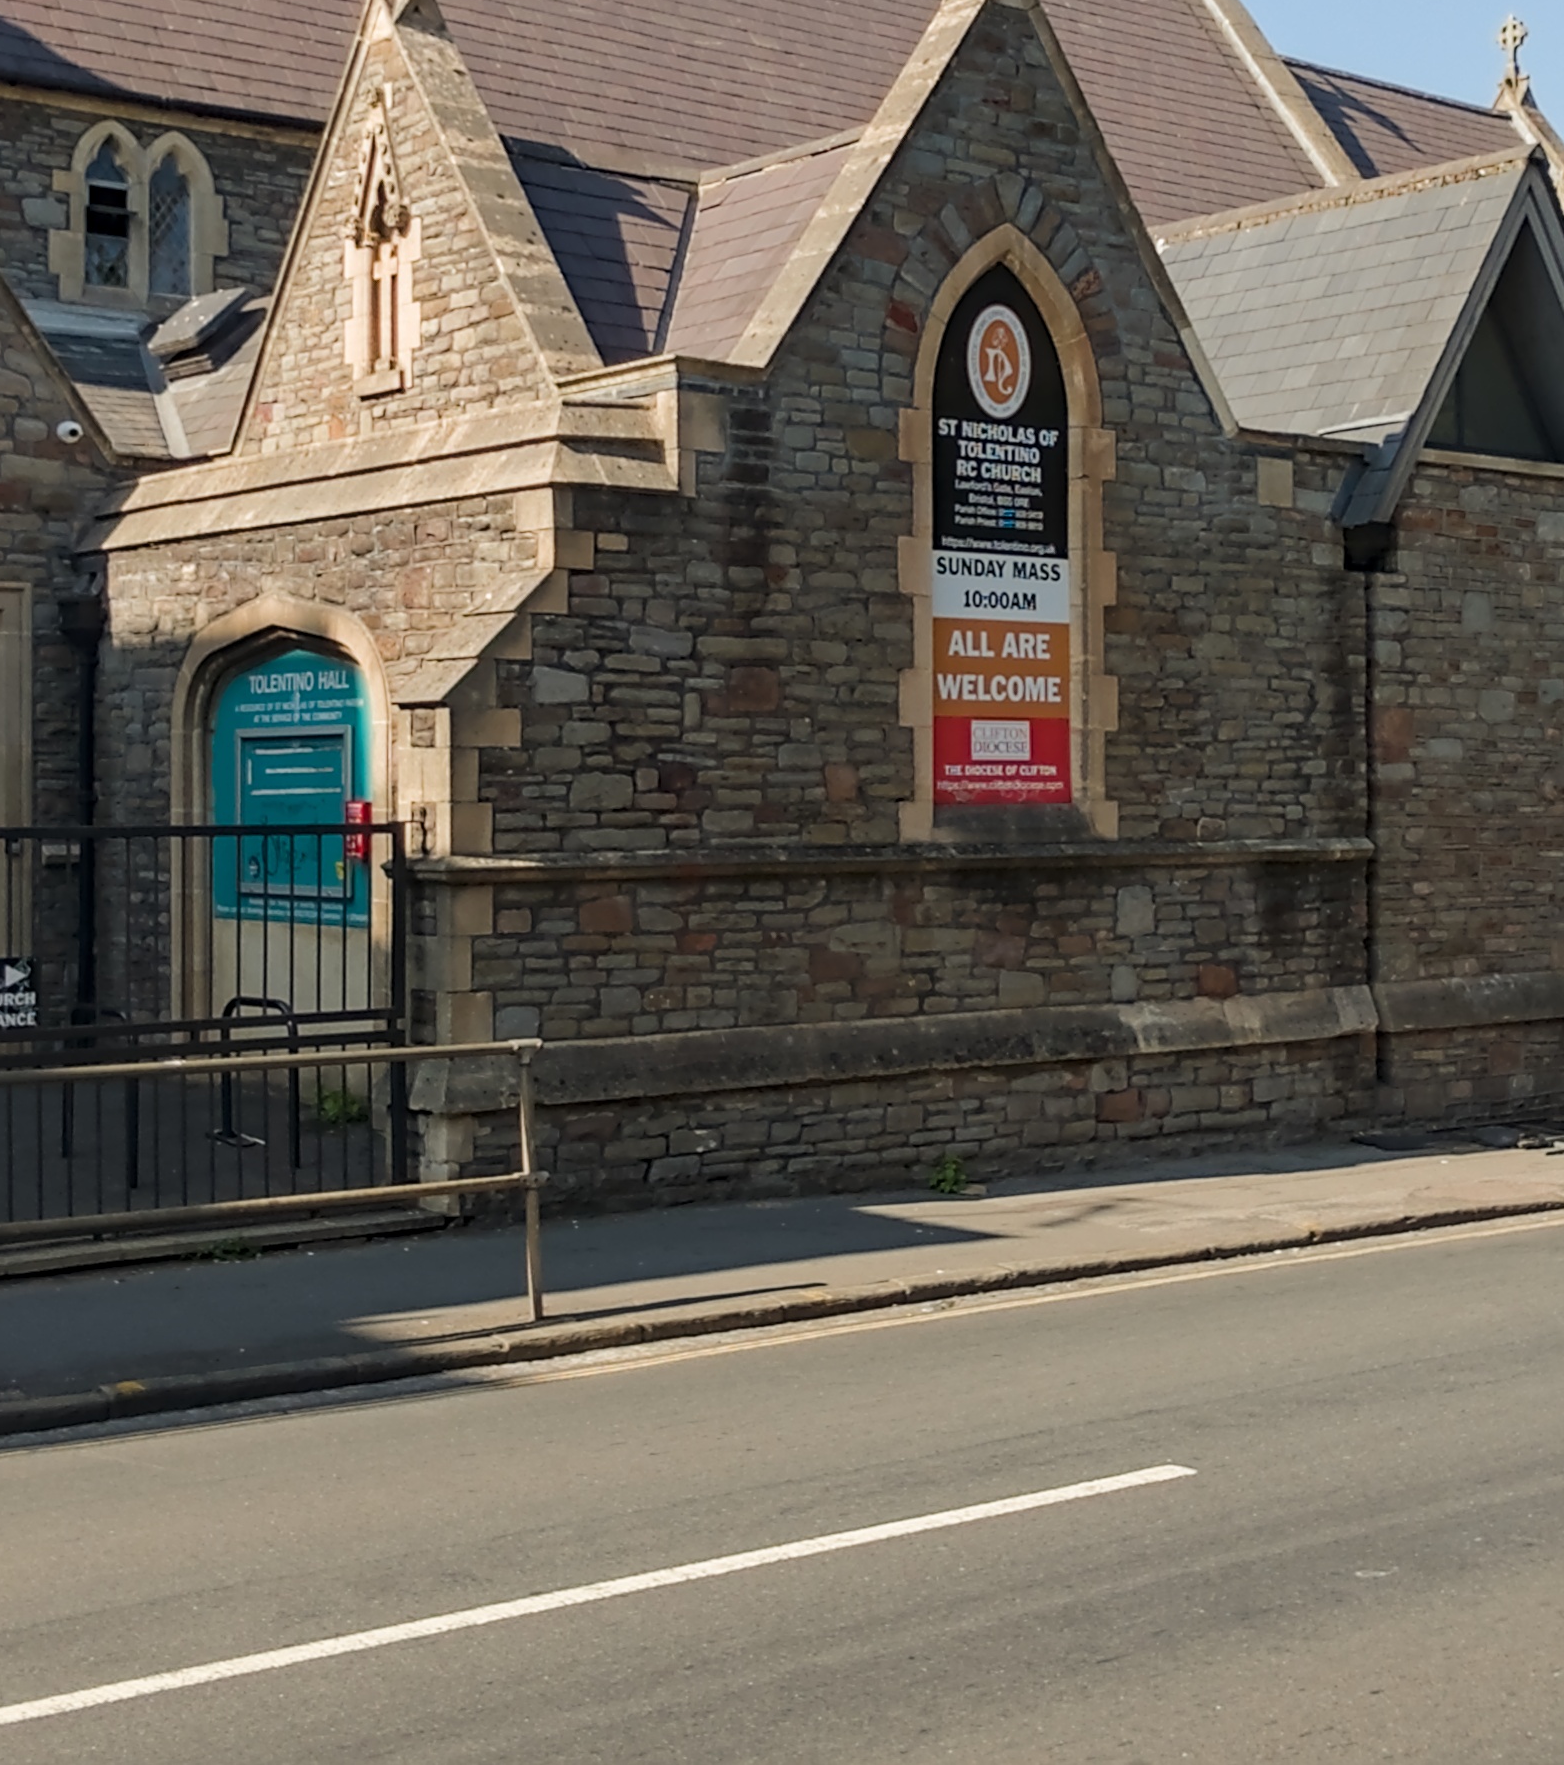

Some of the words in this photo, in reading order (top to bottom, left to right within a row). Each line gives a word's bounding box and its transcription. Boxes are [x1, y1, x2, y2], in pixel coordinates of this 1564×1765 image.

[938, 418, 958, 436] ST
[962, 421, 1035, 445] NICHOLAS
[1039, 430, 1059, 447] OF
[958, 440, 1040, 464] TOLENTINO
[956, 459, 978, 478] RC
[981, 463, 1041, 483] CHURCH
[936, 556, 1006, 579] SUNDAY
[1012, 561, 1061, 582] MASS
[963, 590, 1037, 611] 10:00AM
[948, 630, 994, 658] ALL
[1001, 632, 1051, 660] ARE
[249, 671, 314, 694] TOLENTINO
[318, 670, 350, 690] HALL
[937, 673, 1061, 703] WELCOME
[973, 726, 1028, 740] CLIFTON
[973, 741, 1028, 754] DIOCESE
[945, 764, 963, 776] THE
[965, 764, 1003, 776] DIOCESE
[1005, 764, 1017, 776] OF
[1019, 764, 1057, 776] CLIFTON
